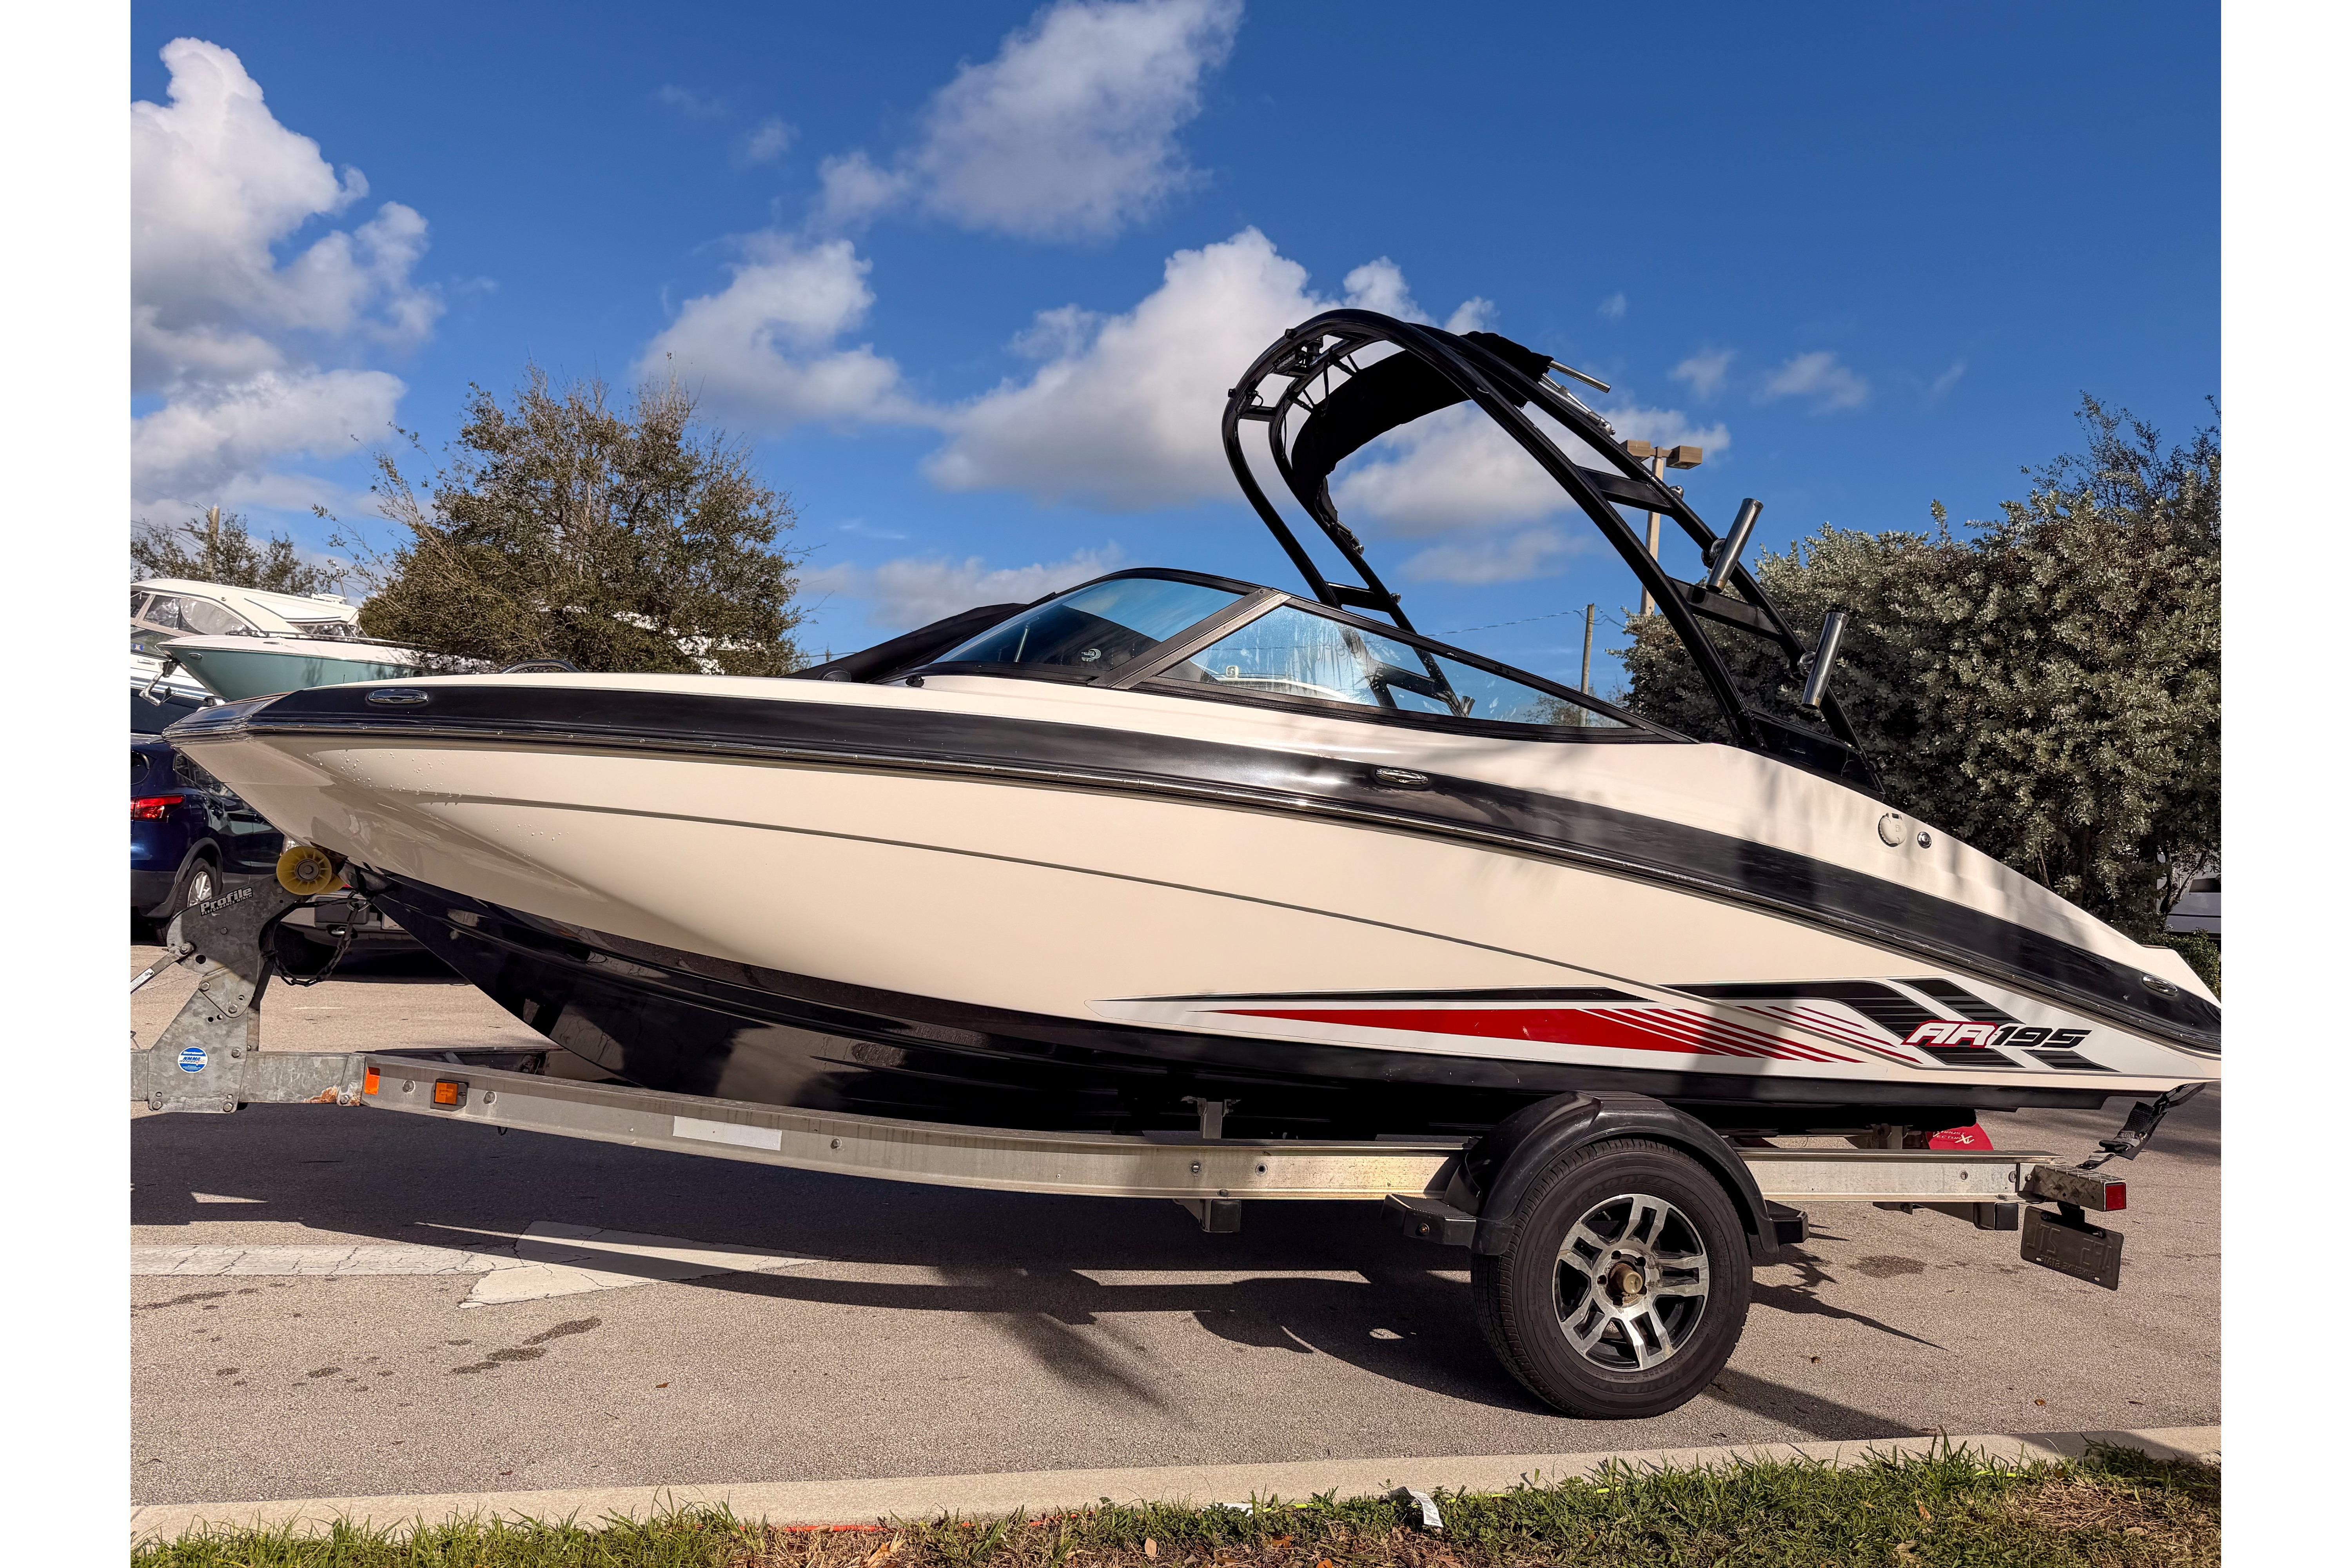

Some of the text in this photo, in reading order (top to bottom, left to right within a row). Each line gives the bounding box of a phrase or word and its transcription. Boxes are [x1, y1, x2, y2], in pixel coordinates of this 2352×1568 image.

[200, 888, 252, 913] Profile
[201, 894, 252, 916] PERFORMANCE WINCH
